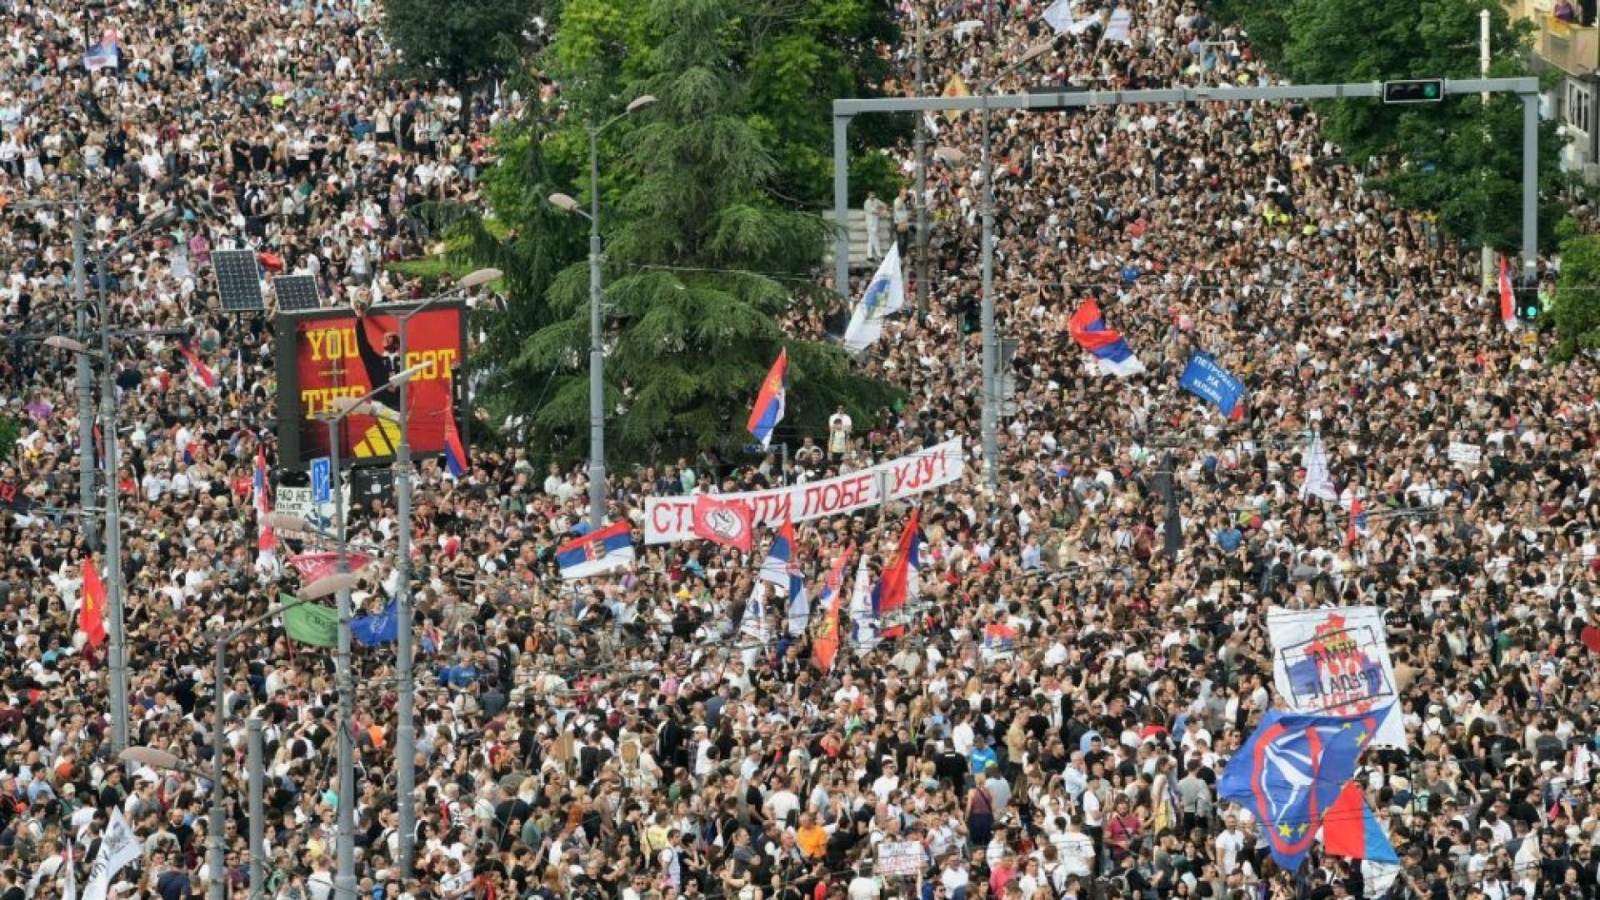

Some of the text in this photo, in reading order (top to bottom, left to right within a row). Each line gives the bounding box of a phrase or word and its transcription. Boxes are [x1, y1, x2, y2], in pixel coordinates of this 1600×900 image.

[306, 328, 359, 361] YOU
[406, 349, 455, 381] GOT
[652, 449, 947, 533] СТУНТИ ПОБЕУЈУ!
